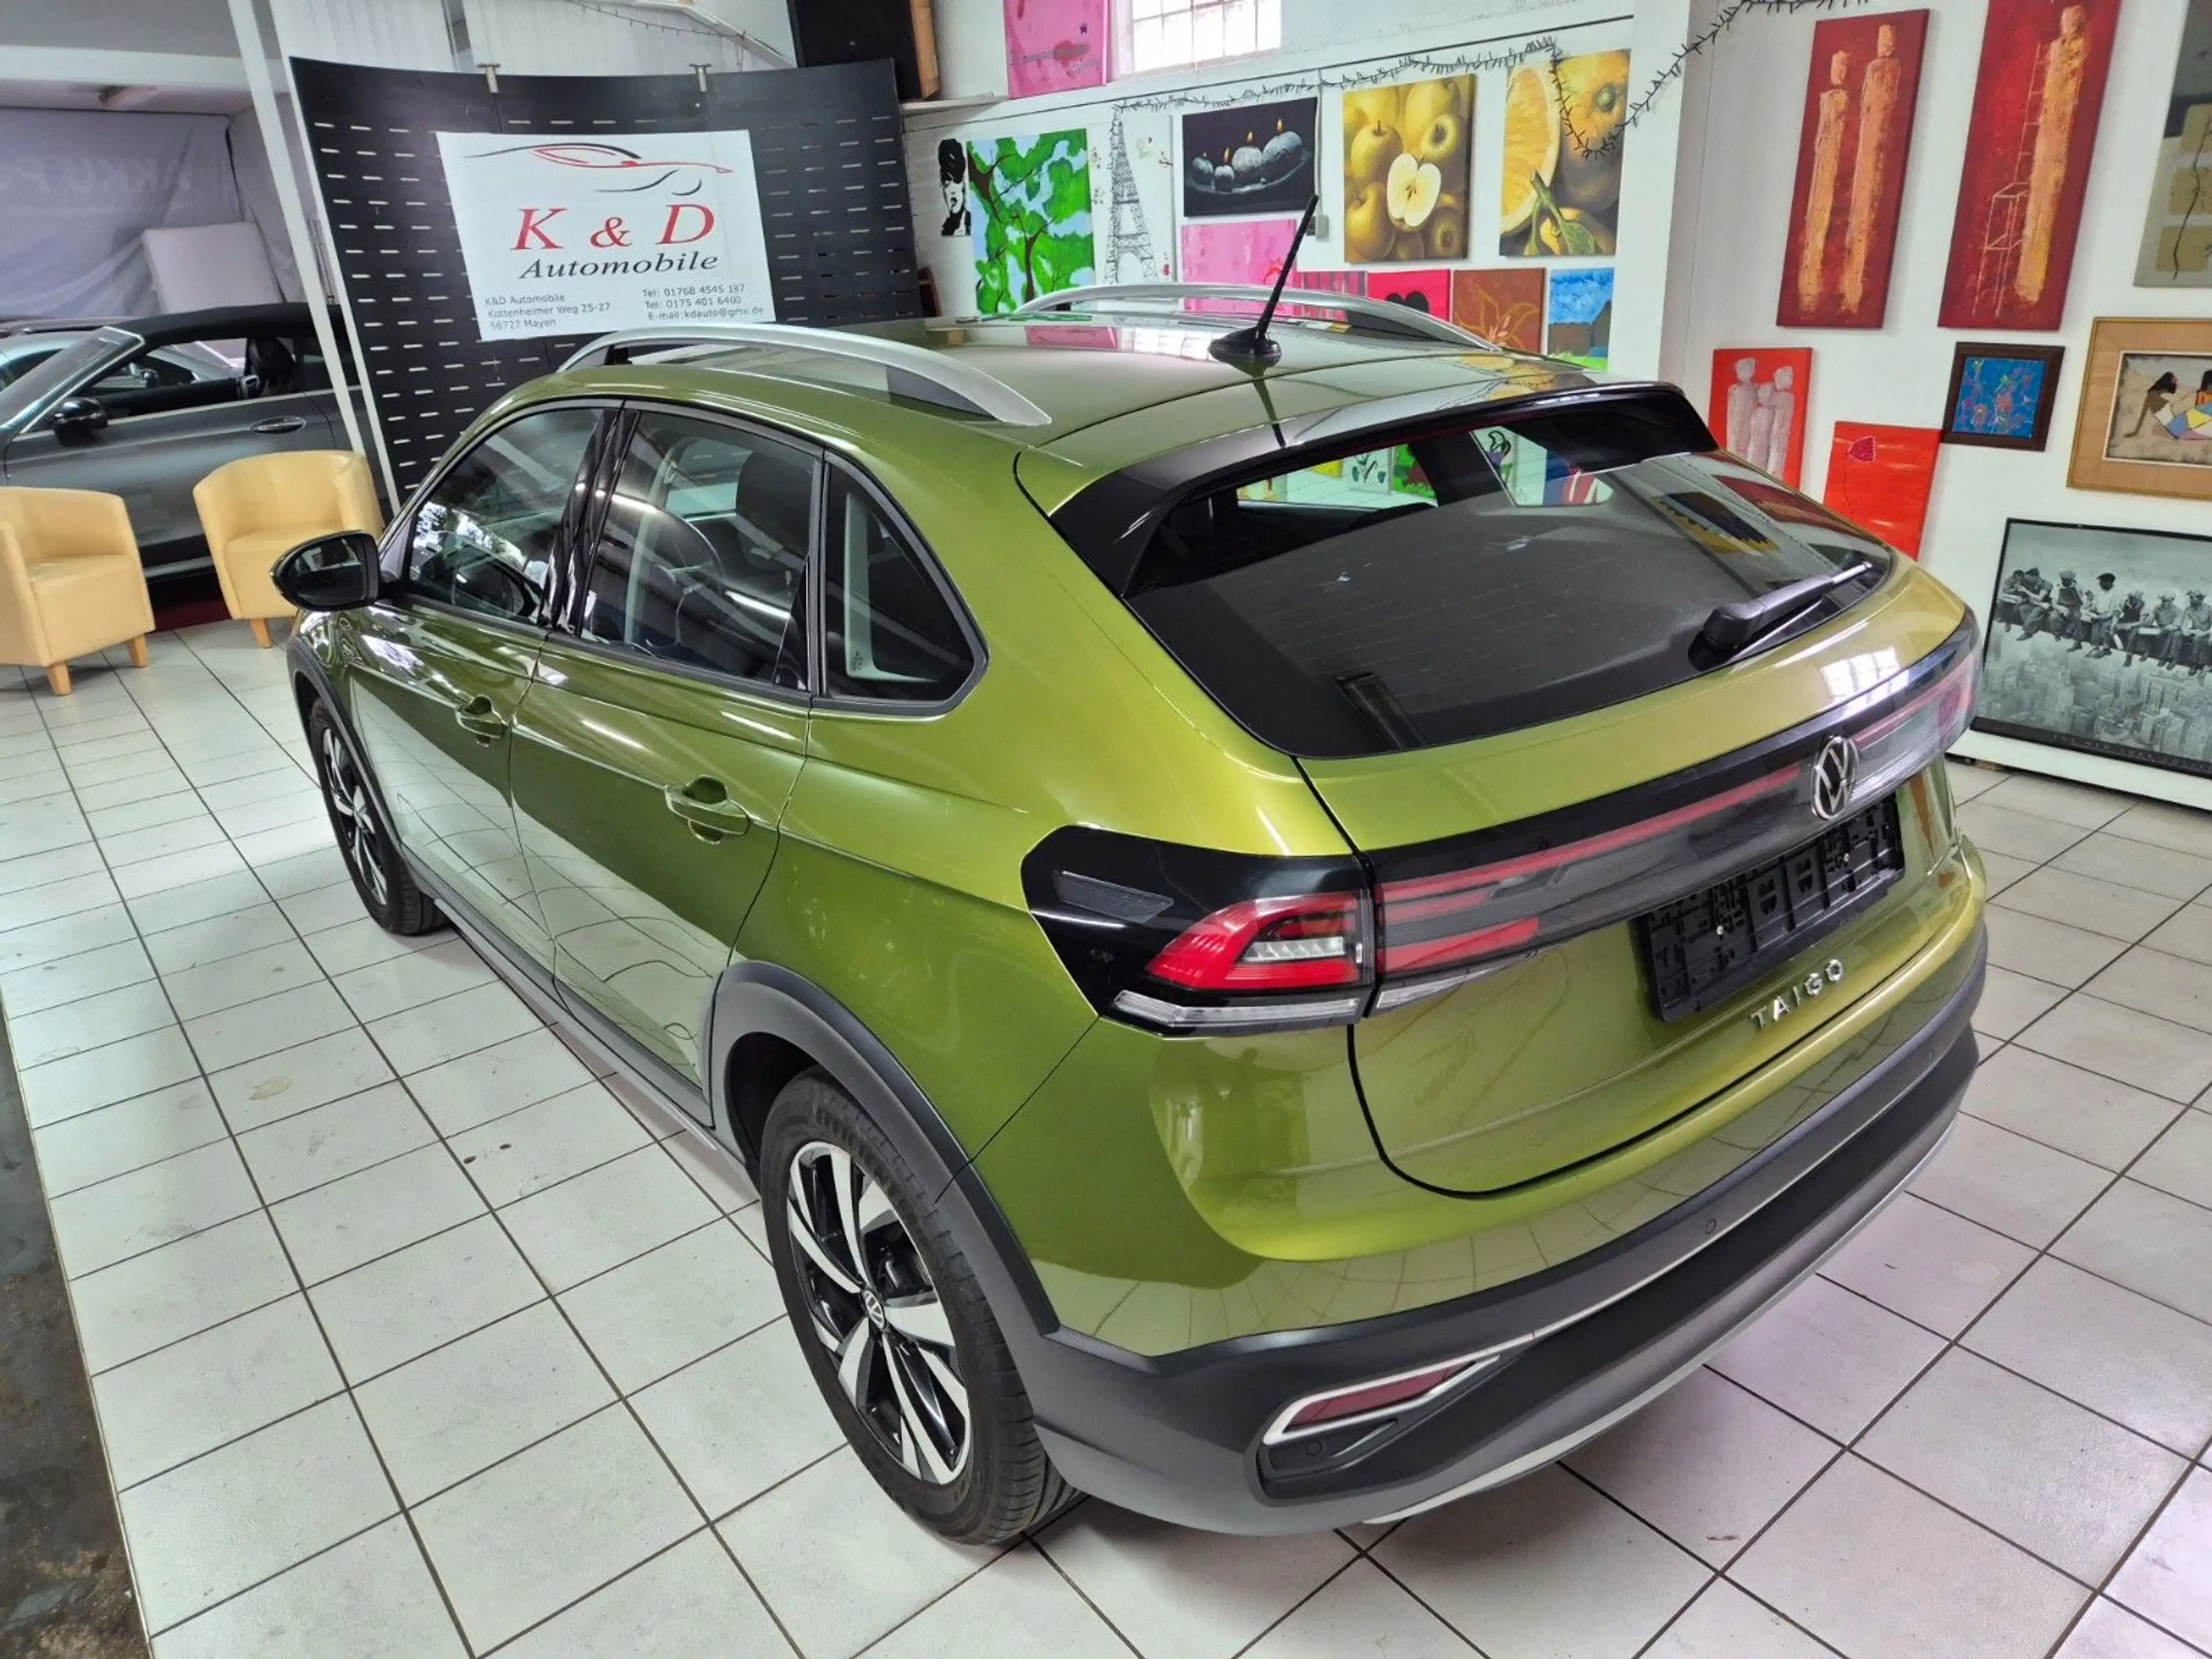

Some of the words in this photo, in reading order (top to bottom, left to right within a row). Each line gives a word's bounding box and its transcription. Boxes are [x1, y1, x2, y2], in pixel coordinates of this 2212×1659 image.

[510, 207, 567, 251] K
[590, 216, 633, 248] &
[656, 204, 715, 245] D
[519, 251, 719, 279] Automobile
[485, 296, 507, 305] K&D
[510, 293, 565, 305] Automobile
[666, 298, 692, 308] 0175
[487, 307, 554, 319] Kottenheimer
[556, 305, 579, 314] Weg
[581, 302, 611, 312] 25-27
[524, 318, 556, 328] Mayen
[1749, 959, 1843, 1029] TAIGO
